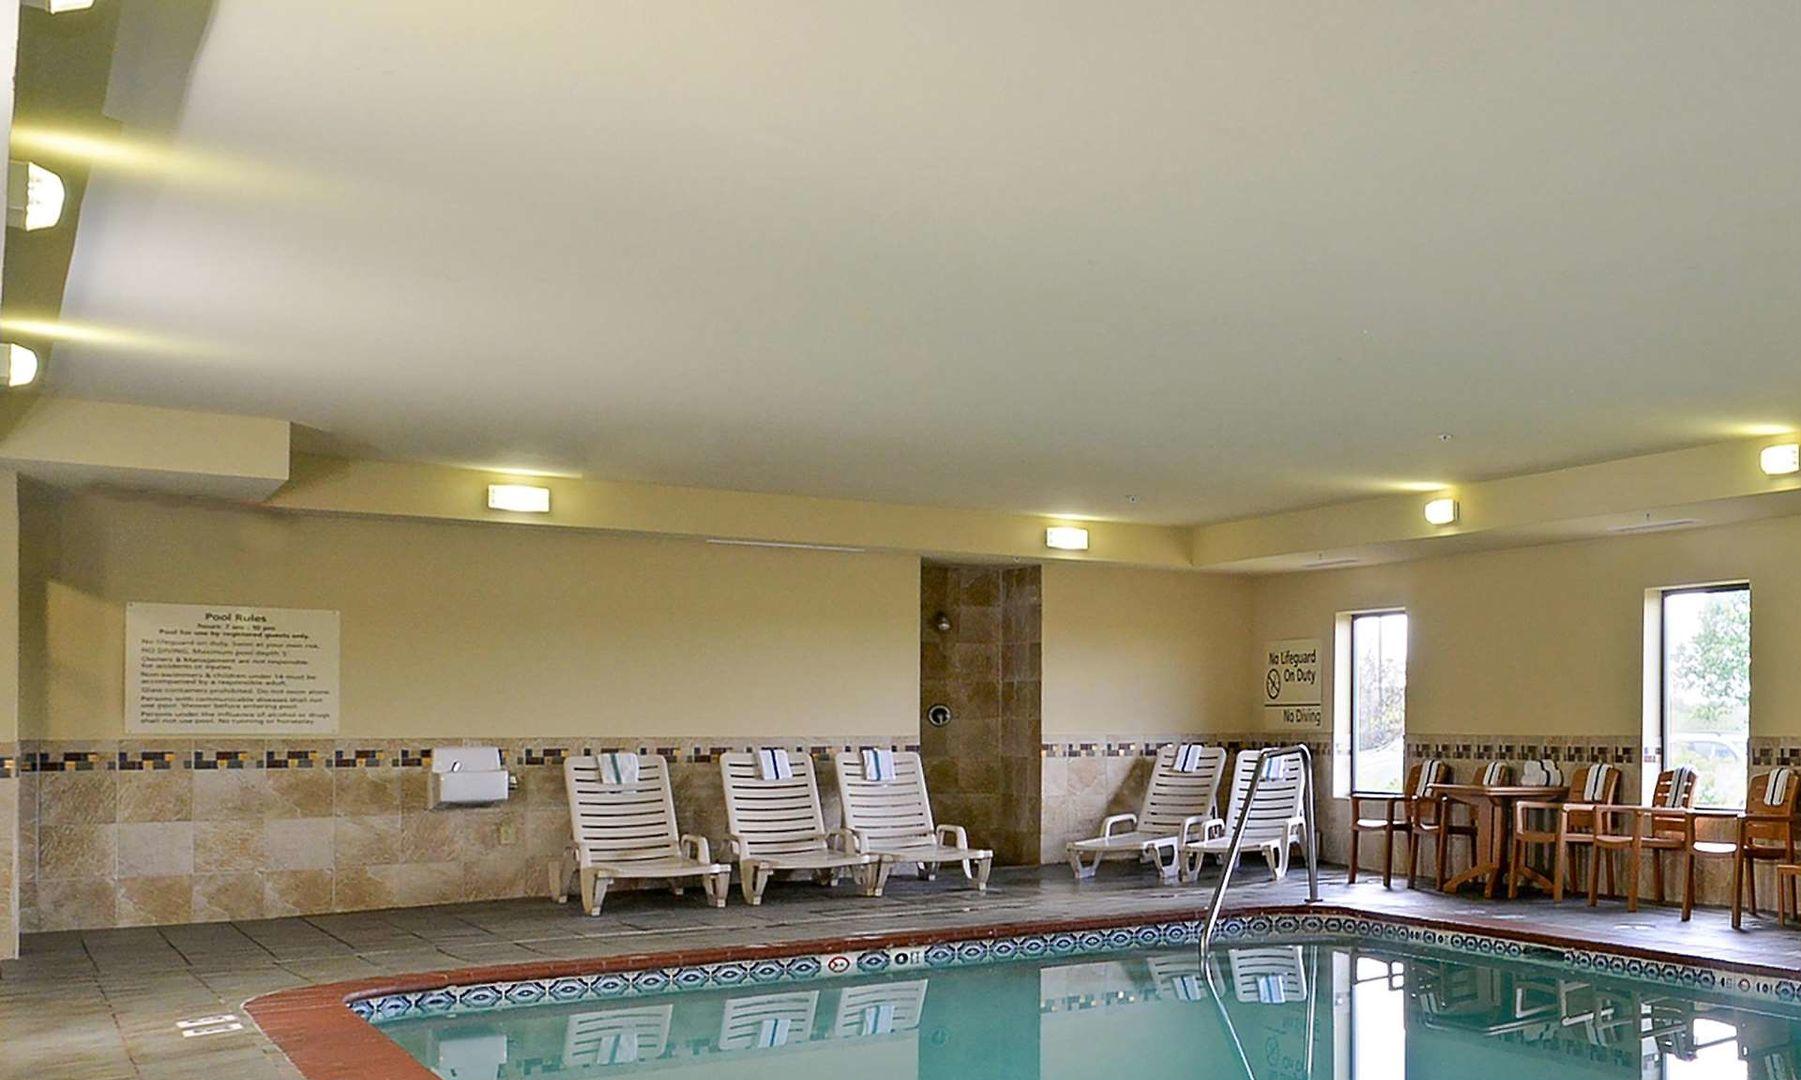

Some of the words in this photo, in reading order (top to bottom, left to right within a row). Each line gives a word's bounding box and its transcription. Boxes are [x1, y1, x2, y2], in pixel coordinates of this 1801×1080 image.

[205, 613, 231, 621] Pool
[235, 614, 266, 622] Rules
[1269, 651, 1279, 666] No
[1280, 649, 1316, 667] Lifeguard
[1284, 668, 1296, 682] On
[1297, 668, 1317, 685] Duty
[1283, 708, 1295, 723] No
[1296, 706, 1322, 727] Diving
